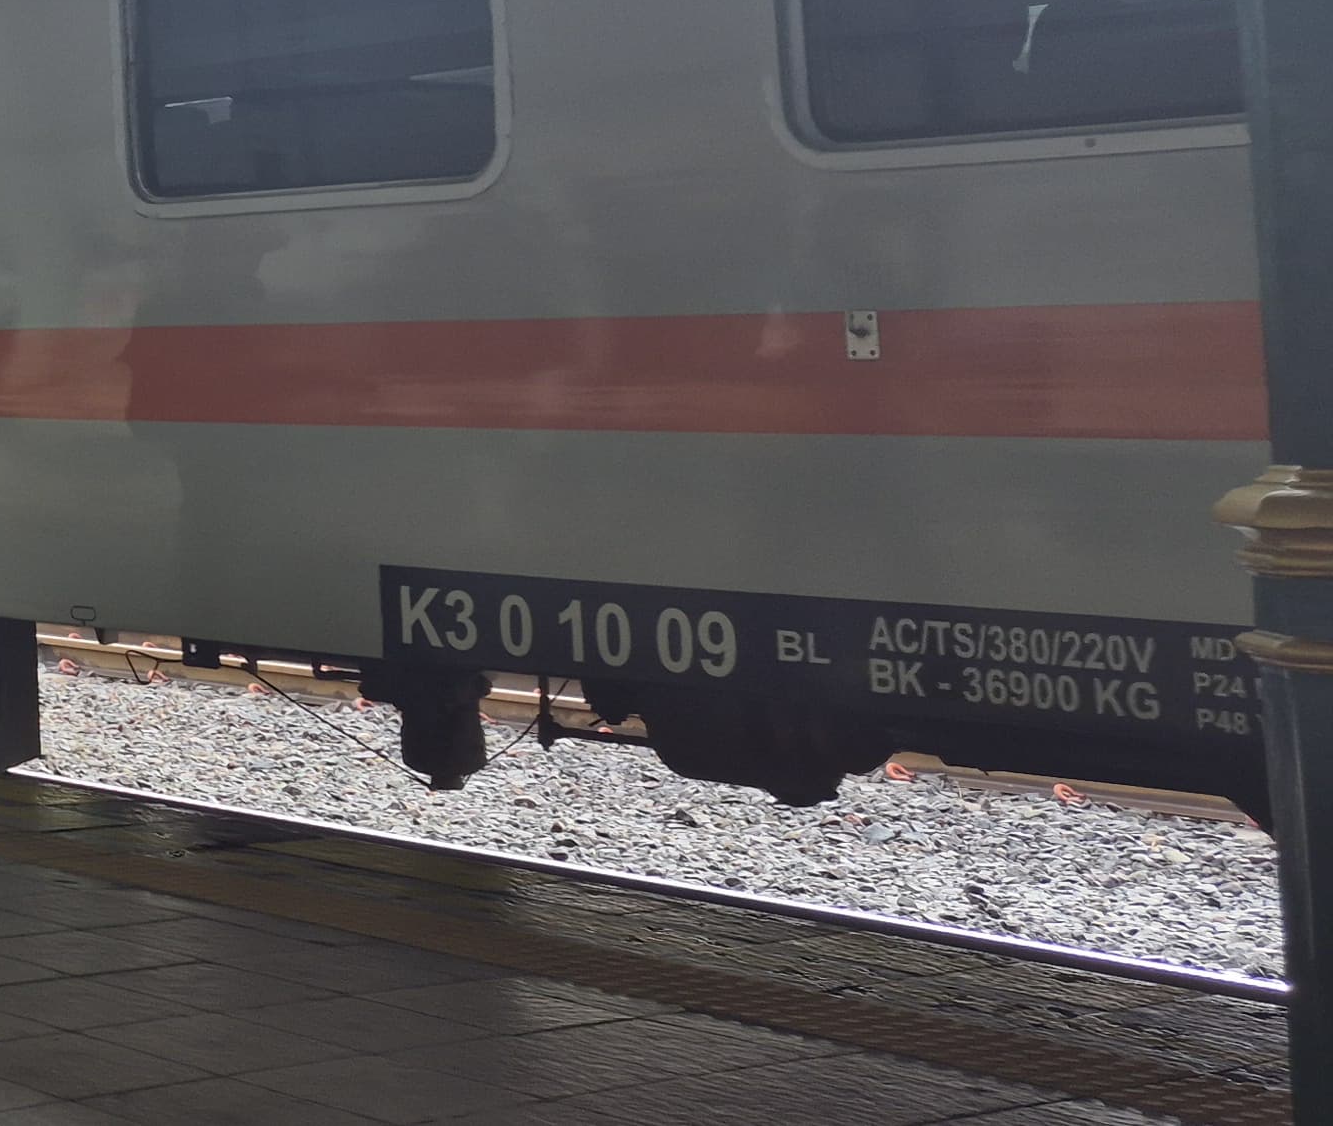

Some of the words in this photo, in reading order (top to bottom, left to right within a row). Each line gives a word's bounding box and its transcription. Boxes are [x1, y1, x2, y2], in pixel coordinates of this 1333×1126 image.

[399, 585, 478, 651] K3
[499, 594, 533, 657] 0
[559, 599, 632, 667] 10
[656, 607, 737, 678] 09
[777, 629, 831, 665] BL
[868, 615, 1156, 674] AC/TS/380/220V
[868, 657, 926, 697] BK
[962, 666, 1080, 712] 36900
[1093, 677, 1161, 720] KG
[1193, 672, 1247, 698] P24
[1196, 708, 1250, 735] P48
